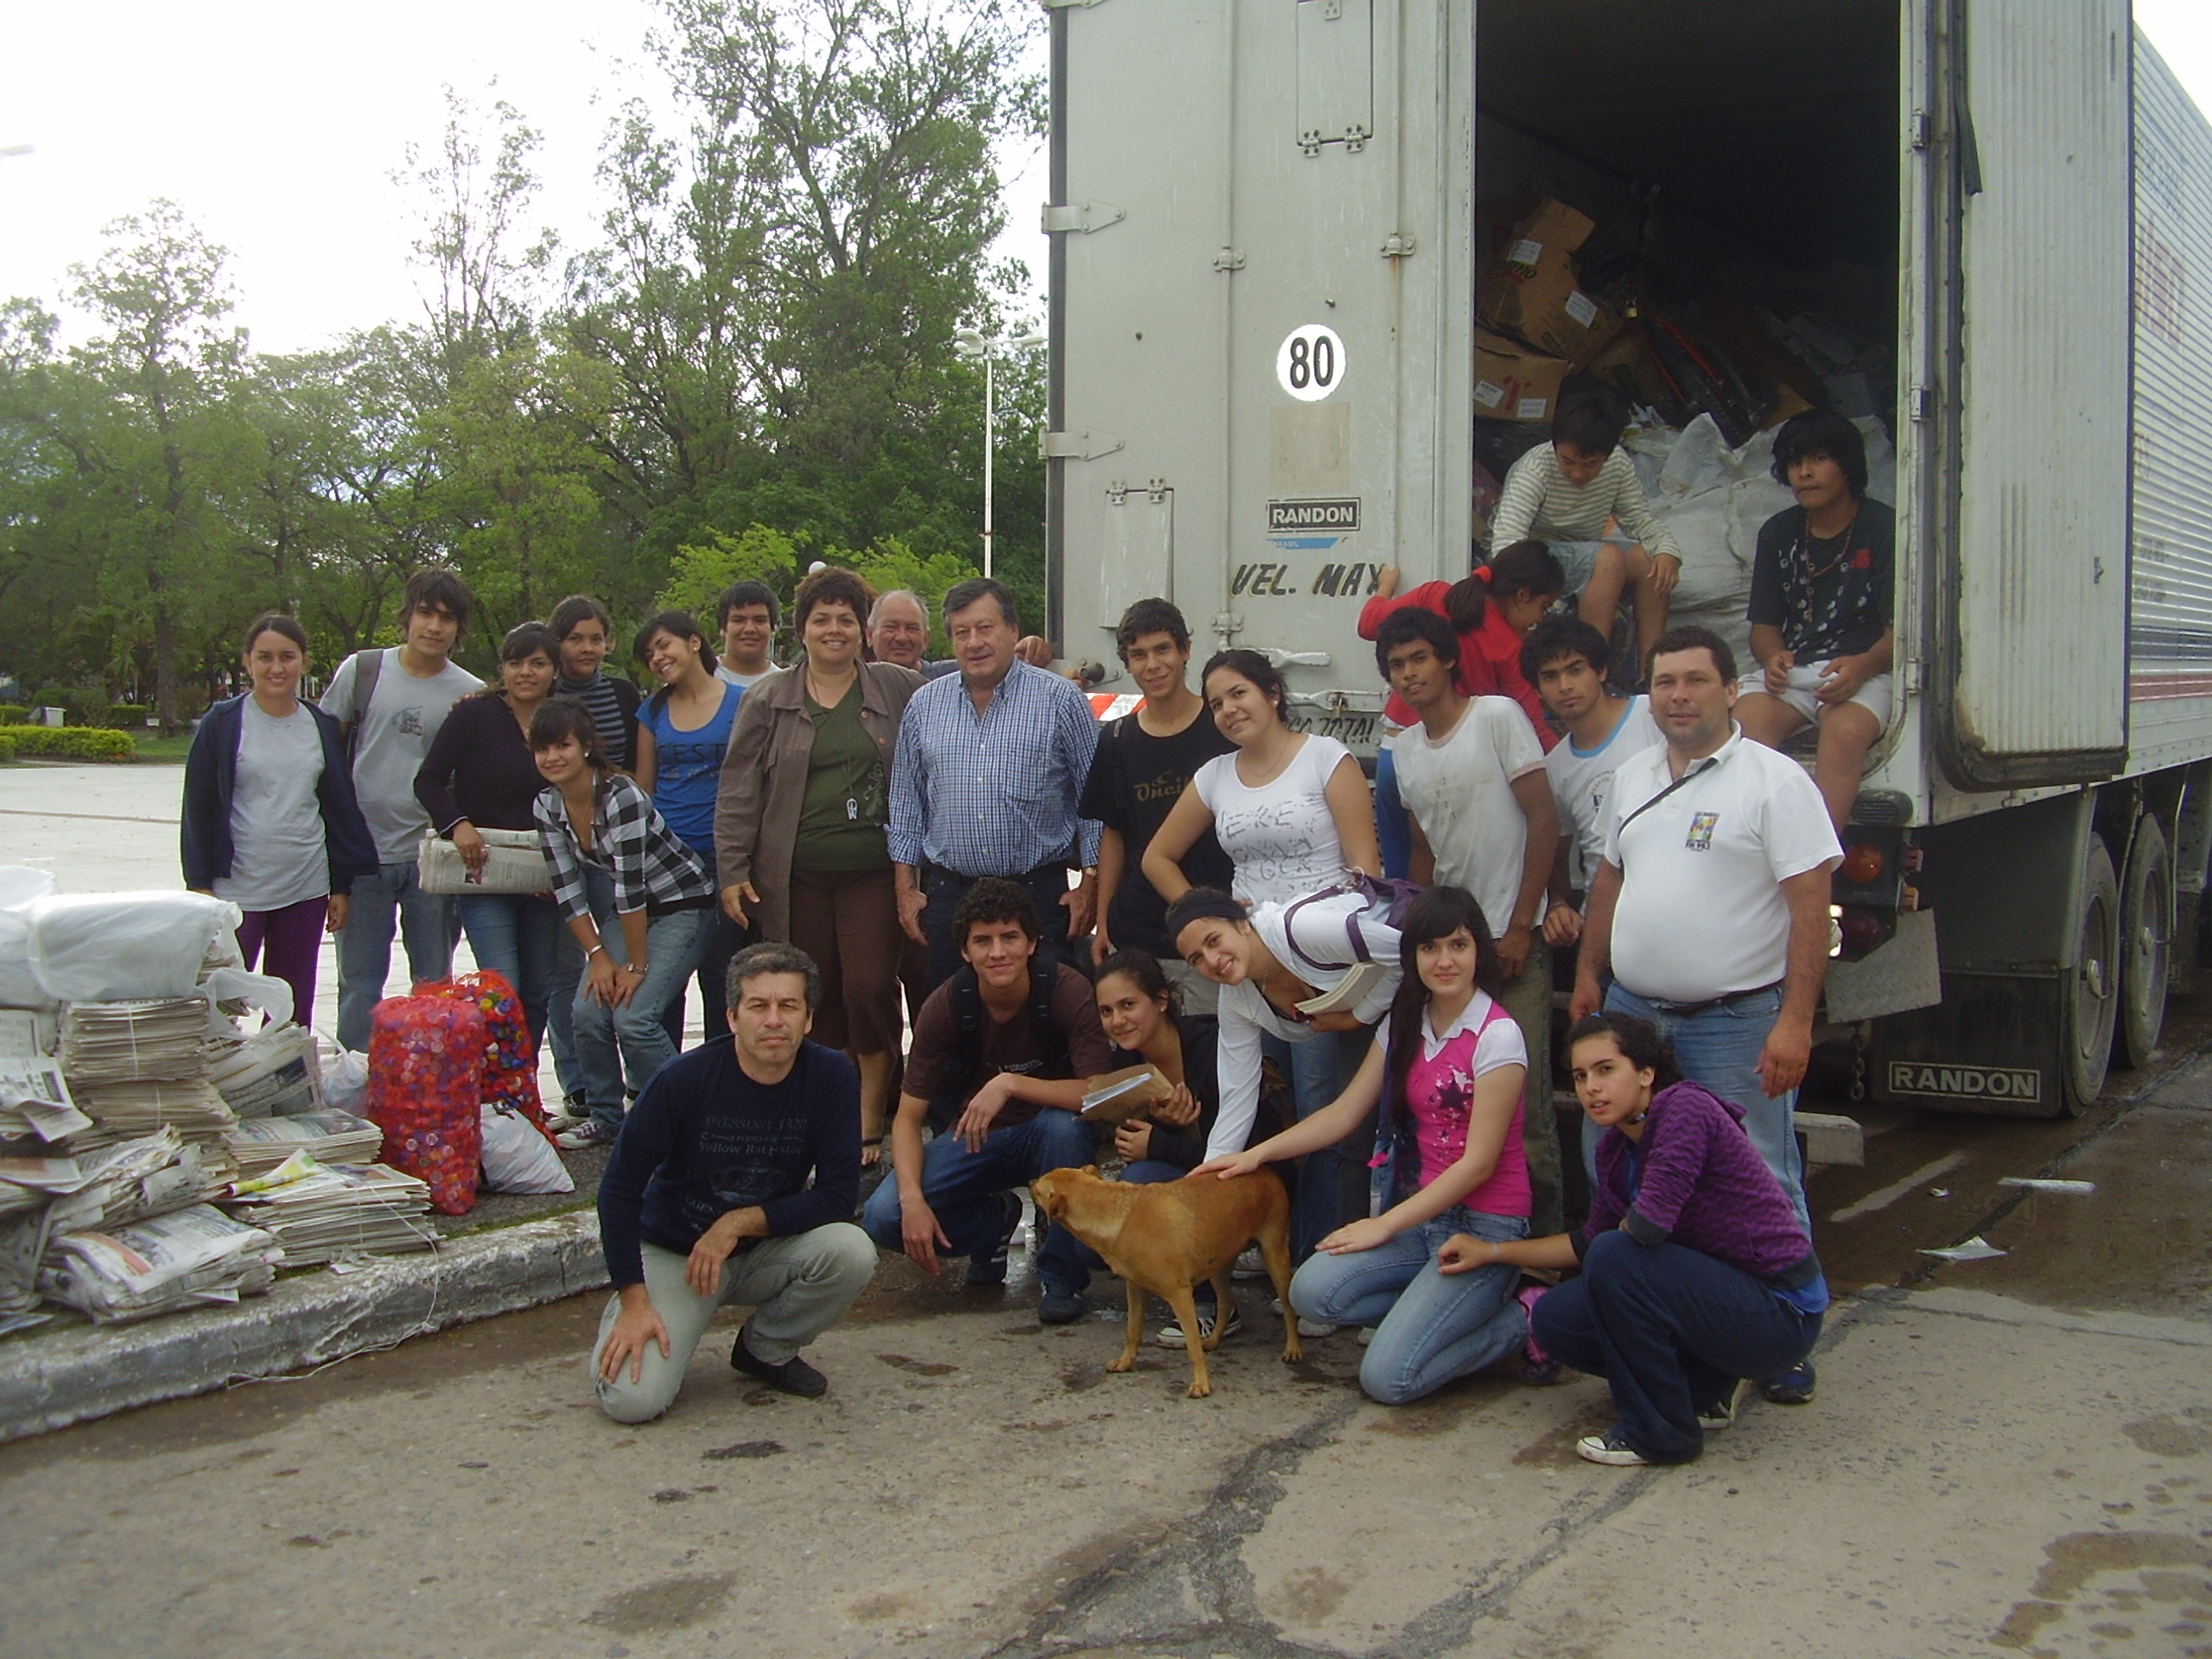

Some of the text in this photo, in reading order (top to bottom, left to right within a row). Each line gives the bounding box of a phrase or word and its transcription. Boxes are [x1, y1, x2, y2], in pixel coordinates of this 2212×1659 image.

[1290, 335, 1334, 389] 80
[1272, 506, 1354, 524] RANDON
[1230, 563, 1297, 598] VEL.
[1894, 1066, 2035, 1097] RANDON
